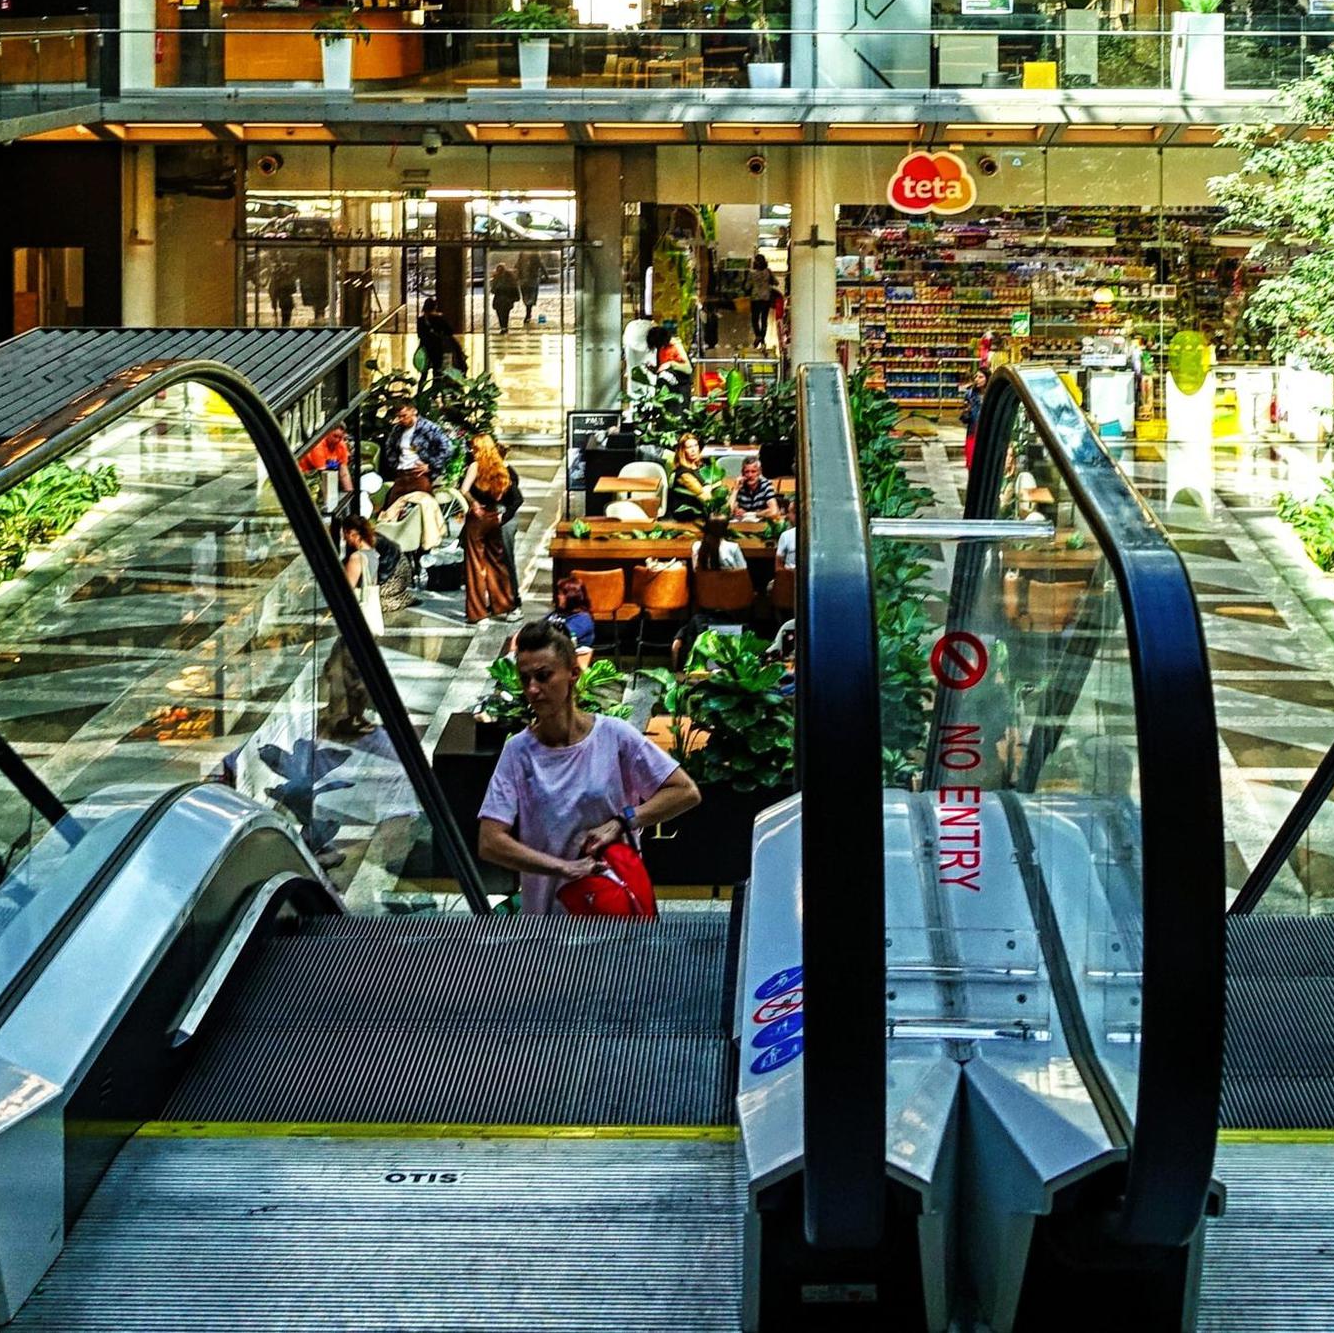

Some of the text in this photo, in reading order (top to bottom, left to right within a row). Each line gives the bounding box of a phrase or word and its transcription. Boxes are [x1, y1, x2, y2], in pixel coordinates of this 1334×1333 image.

[902, 175, 964, 200] teta
[938, 724, 981, 892] NO ENTRY
[385, 1172, 459, 1184] OTIS
